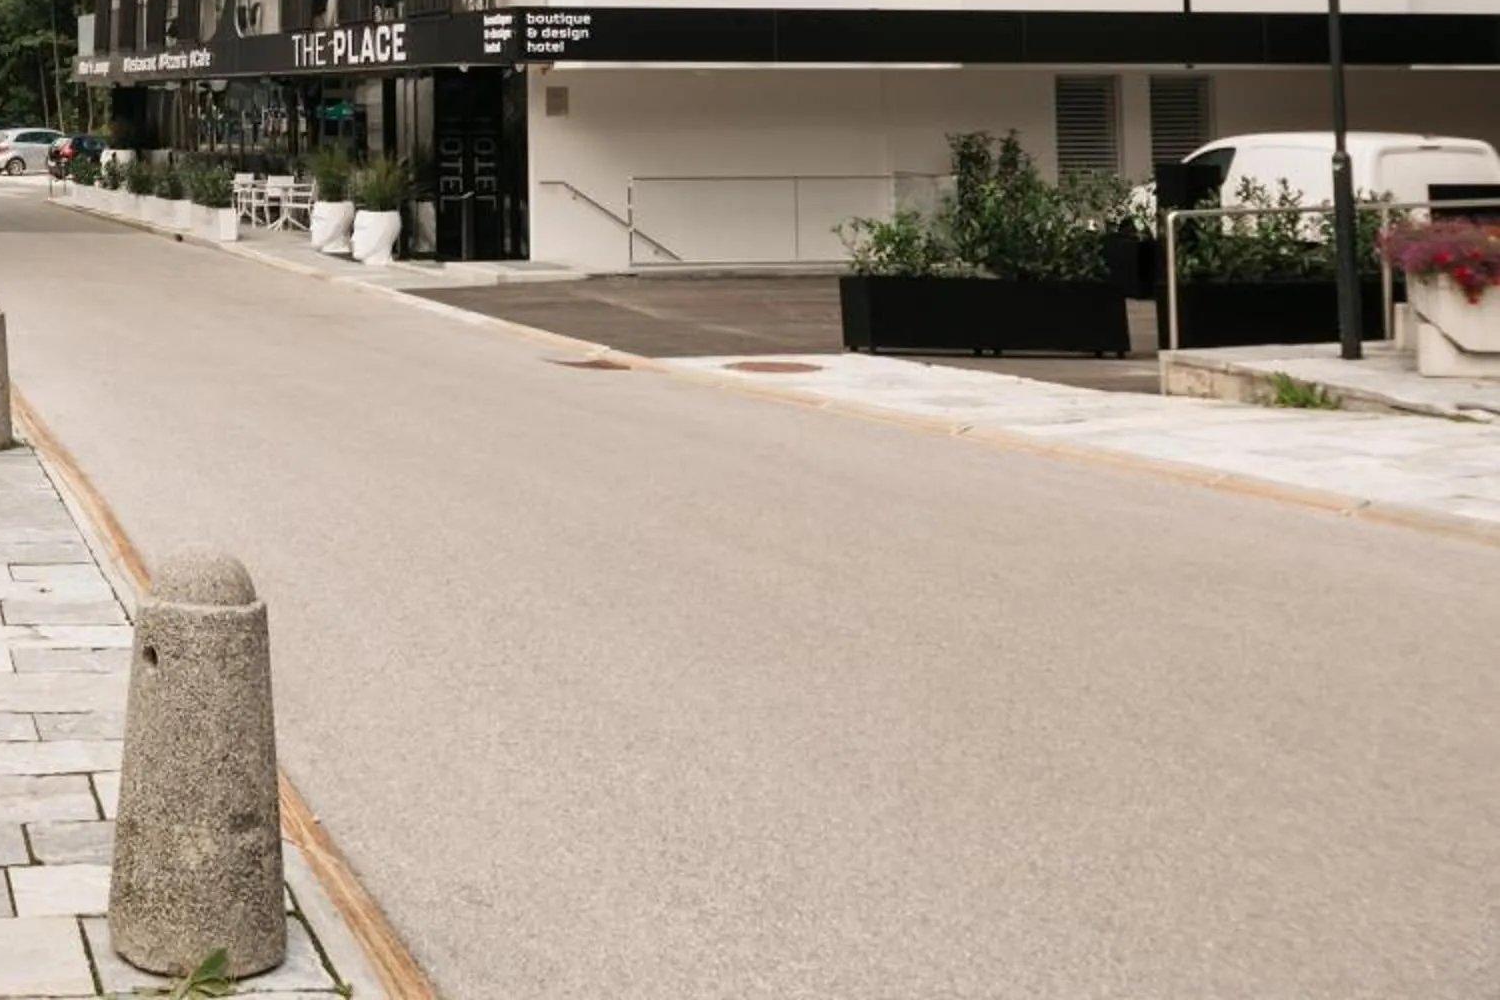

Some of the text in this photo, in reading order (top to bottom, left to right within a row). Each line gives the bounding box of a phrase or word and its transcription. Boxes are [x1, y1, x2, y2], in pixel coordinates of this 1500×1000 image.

[525, 13, 592, 27] boutique
[526, 27, 538, 39] &
[541, 27, 590, 41] design
[291, 23, 408, 67] THE PLACE
[526, 41, 566, 53] hotel
